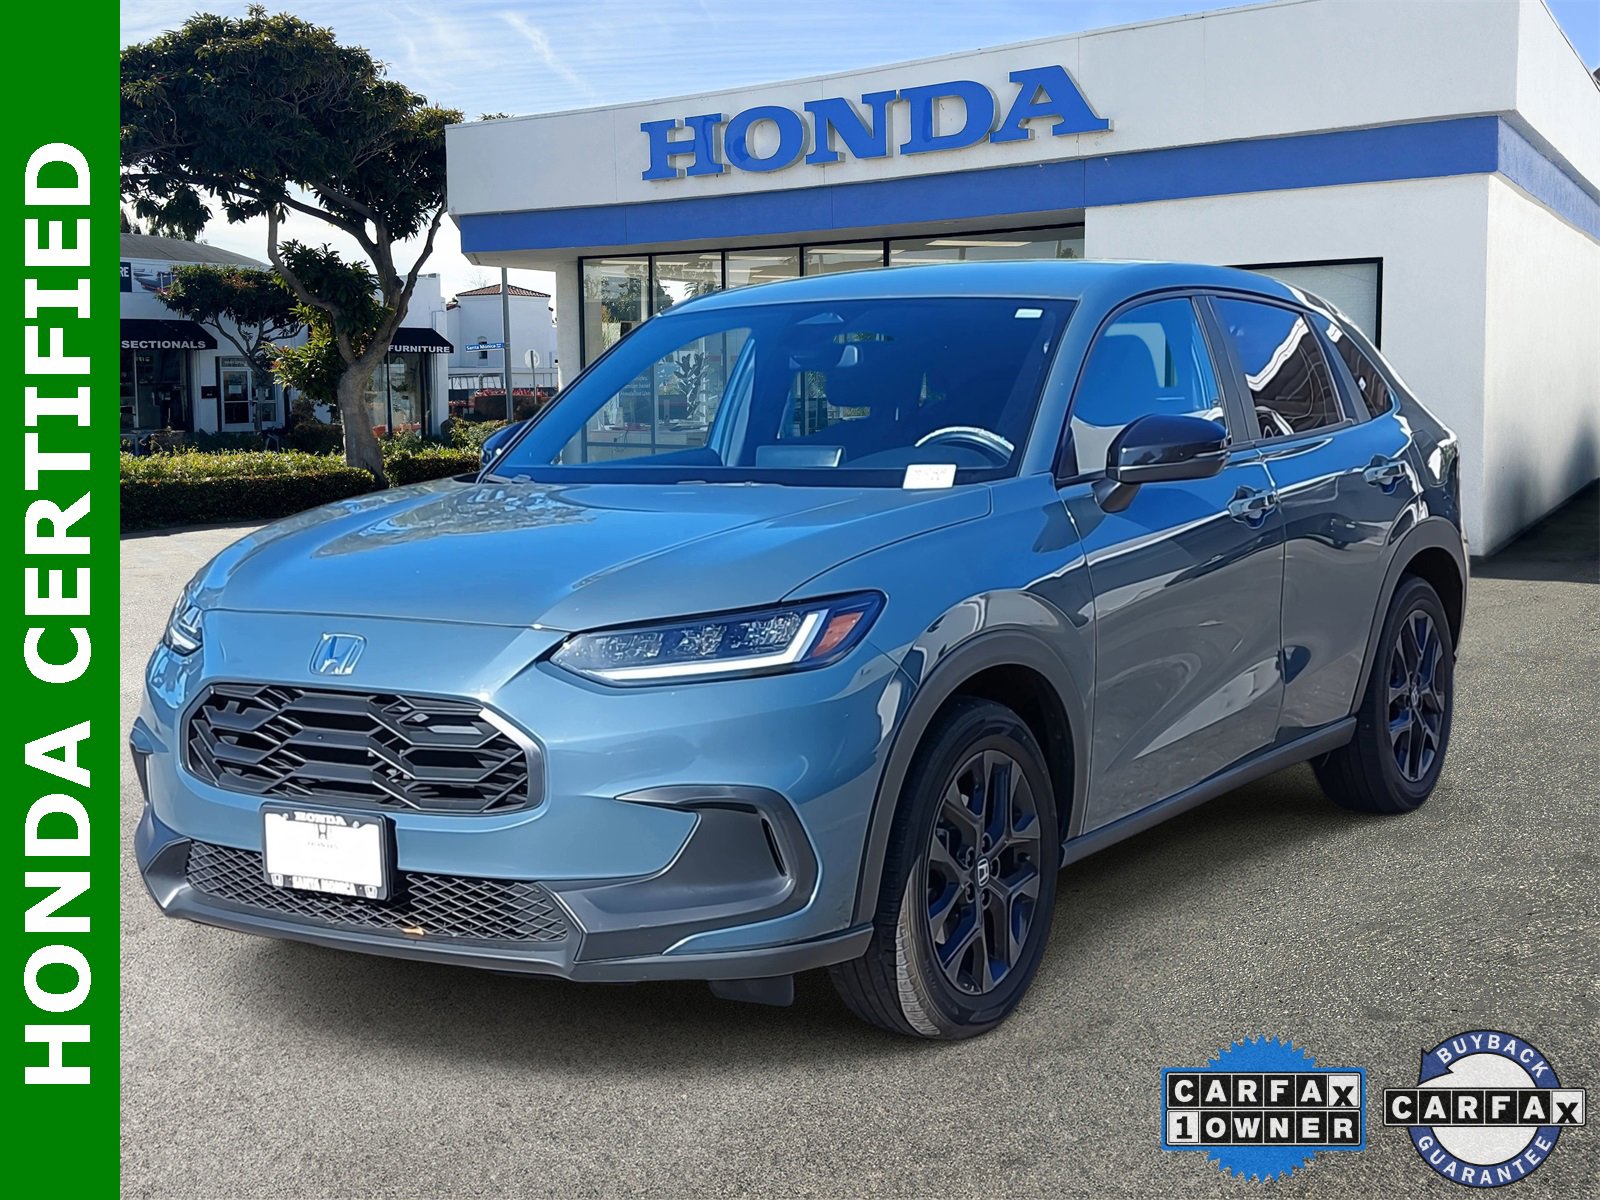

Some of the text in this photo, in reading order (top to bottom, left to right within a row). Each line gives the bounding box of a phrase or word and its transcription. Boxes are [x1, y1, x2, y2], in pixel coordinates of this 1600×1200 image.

[640, 65, 1113, 181] HONDA
[121, 340, 206, 349] SECTIONALS
[388, 344, 450, 353] FURNITURE
[294, 811, 347, 826] HONDA
